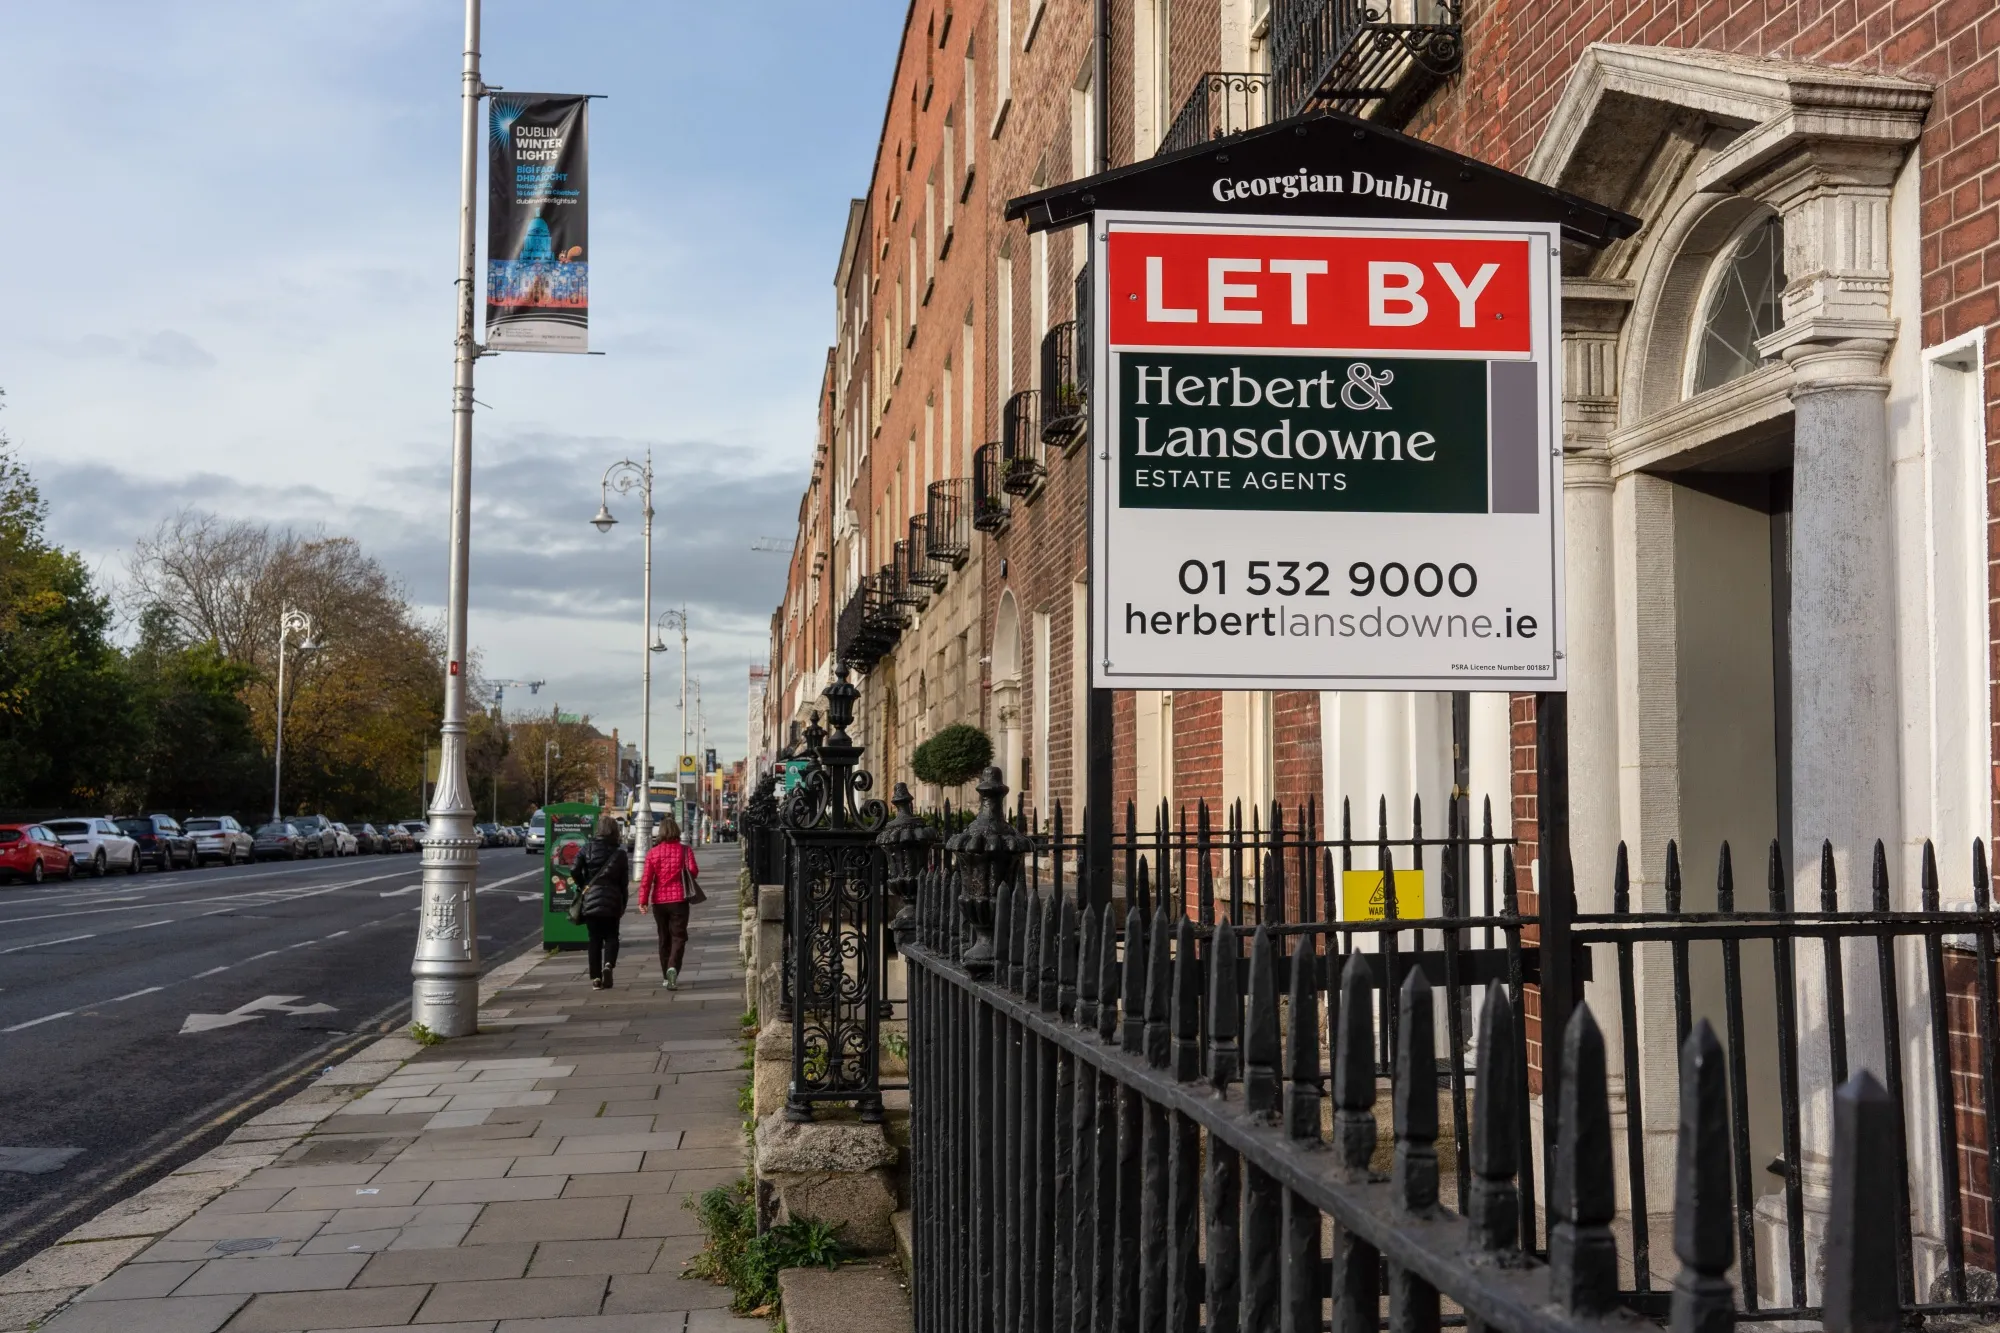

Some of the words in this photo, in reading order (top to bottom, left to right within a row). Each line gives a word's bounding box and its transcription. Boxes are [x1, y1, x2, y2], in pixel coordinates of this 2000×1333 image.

[516, 126, 558, 137] DUBLIN
[516, 138, 563, 149] WINTER
[516, 150, 558, 160] LIGHTS
[1212, 167, 1344, 202] Georgian
[1350, 170, 1449, 210] Dublin
[1145, 256, 1328, 324] LET
[1368, 261, 1501, 328] BY
[1134, 416, 1437, 462] Lansdowne
[1135, 469, 1231, 489] ESTATE
[1242, 471, 1348, 491] AGENTS
[1178, 559, 1227, 595] 01
[1246, 560, 1331, 597] 532
[1348, 561, 1478, 598] 9000
[1125, 602, 1538, 639] herbertlansdowne.ie
[1451, 663, 1469, 671] PSRA
[1470, 663, 1496, 671] Licence
[1368, 907, 1399, 915] WARG
